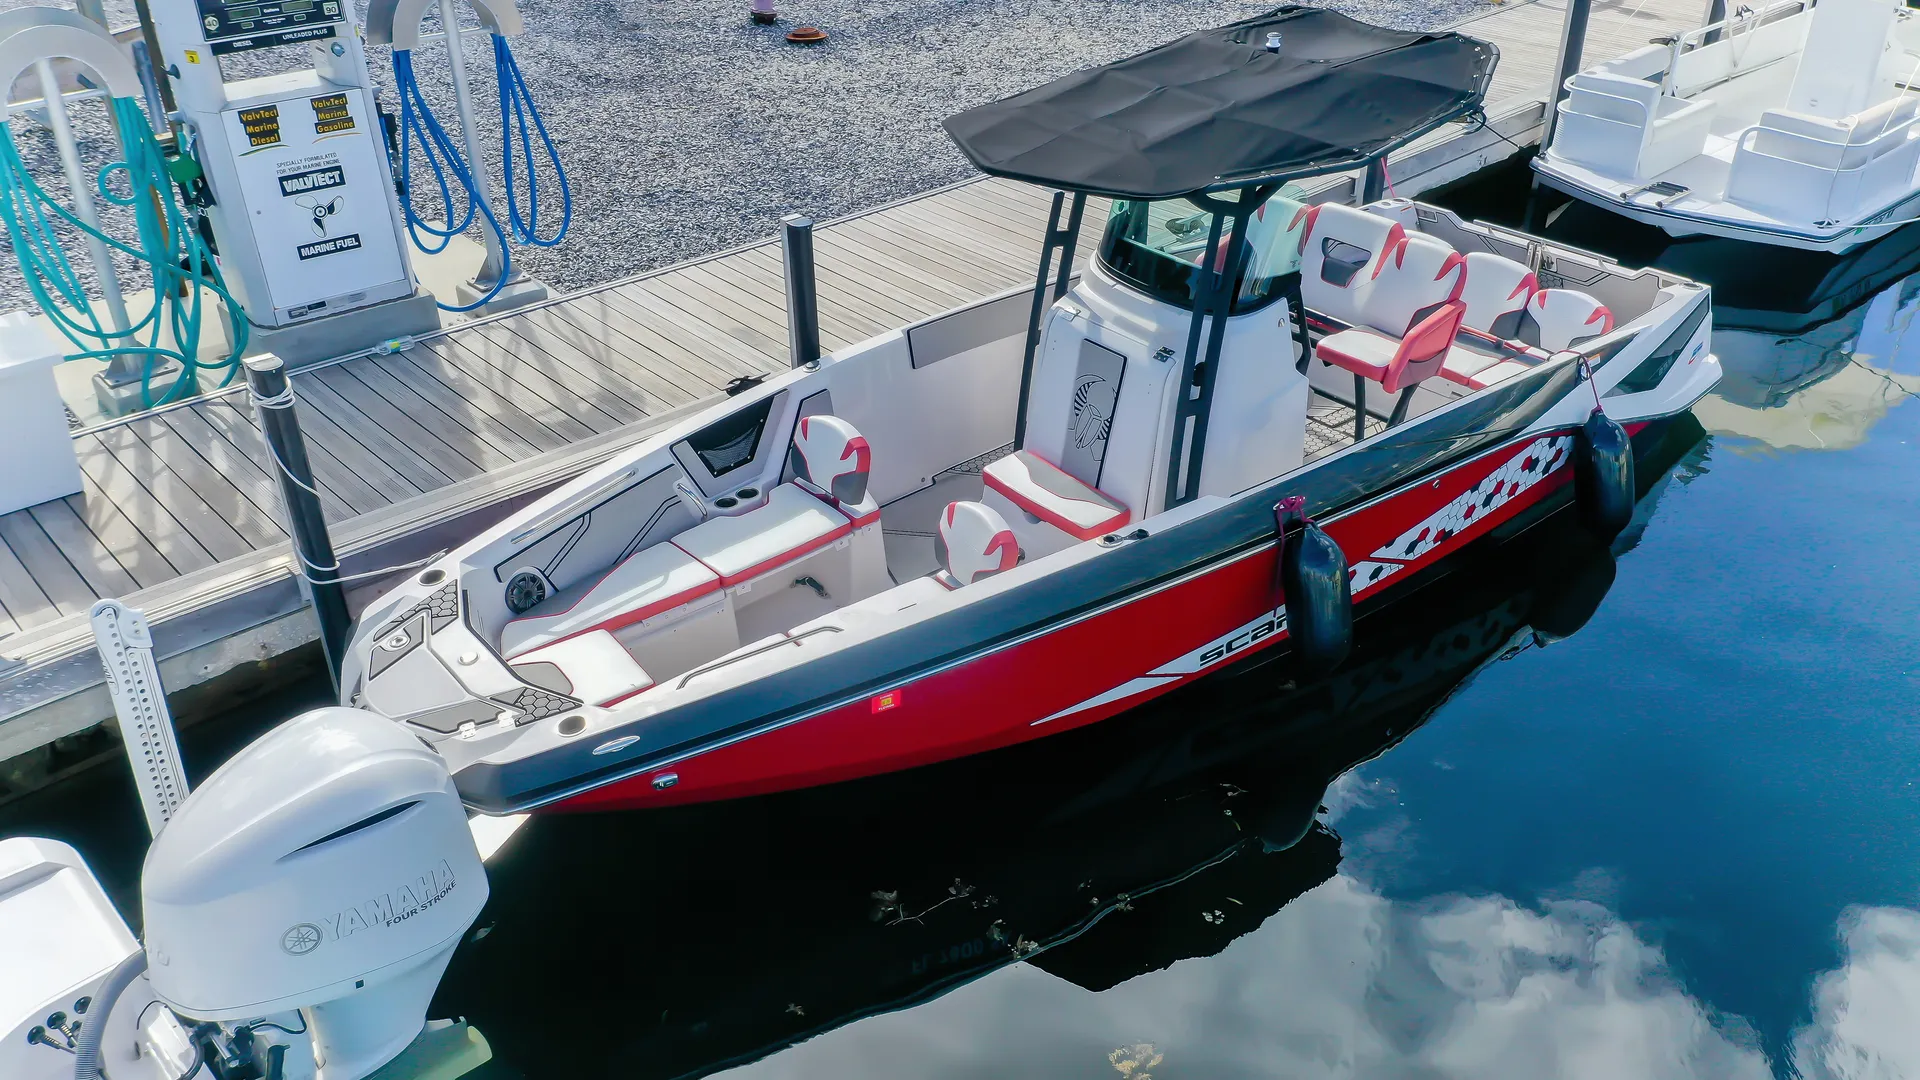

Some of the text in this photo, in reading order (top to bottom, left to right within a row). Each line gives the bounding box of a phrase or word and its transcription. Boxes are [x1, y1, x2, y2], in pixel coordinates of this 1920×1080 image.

[282, 28, 328, 40] UNLEADED PLUS
[233, 40, 253, 48] DIESEL
[312, 97, 346, 109] ValvTect
[240, 110, 277, 122] ValvTect
[318, 110, 347, 120] Marine
[246, 122, 278, 134] Marine
[317, 121, 354, 133] Gasoline
[250, 134, 279, 146] Diesel
[276, 152, 337, 168] SPECIALLY FORMULATED
[288, 165, 302, 173] YOUR
[302, 161, 322, 170] MARINE
[322, 158, 341, 166] ENGINE
[282, 171, 341, 193] VALVTECT
[301, 237, 358, 257] MARINE FUEL
[317, 858, 455, 942] YAMAHA
[386, 879, 457, 928] FOUR STROKE
